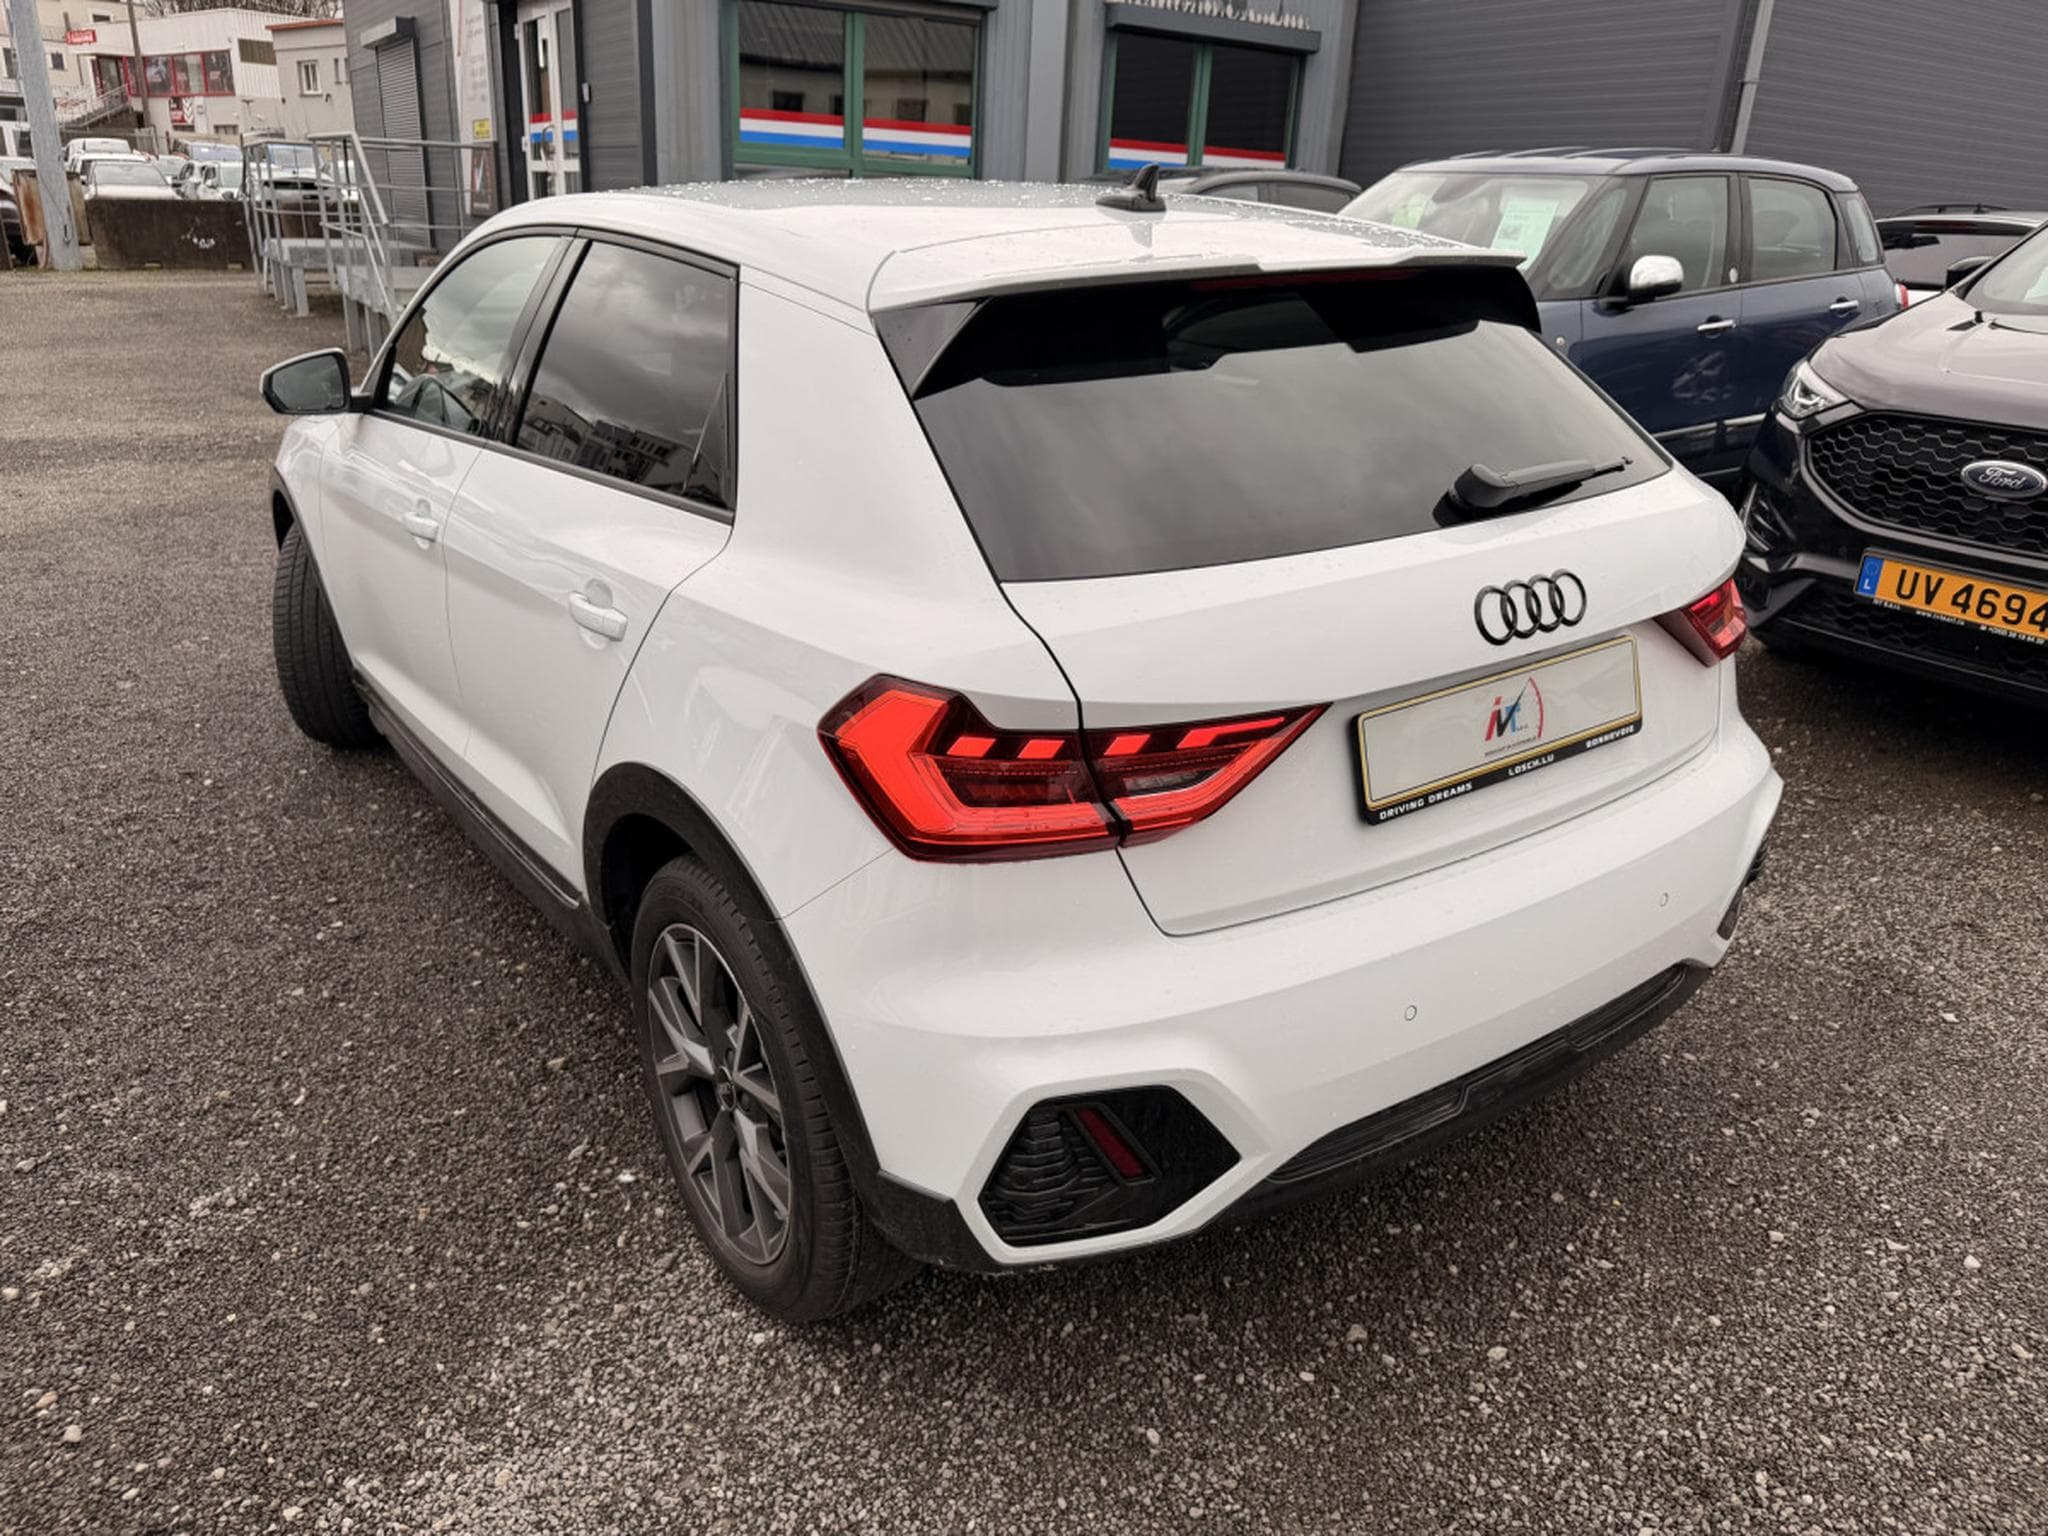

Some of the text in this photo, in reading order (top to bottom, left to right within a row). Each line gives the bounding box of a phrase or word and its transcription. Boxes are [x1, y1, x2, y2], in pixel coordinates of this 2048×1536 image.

[1979, 466, 2027, 489] Ford
[1863, 578, 1871, 590] L
[1896, 569, 2048, 632] UV 4694
[1380, 798, 1425, 820] DRIVING
[1428, 782, 1473, 803] DREAMS
